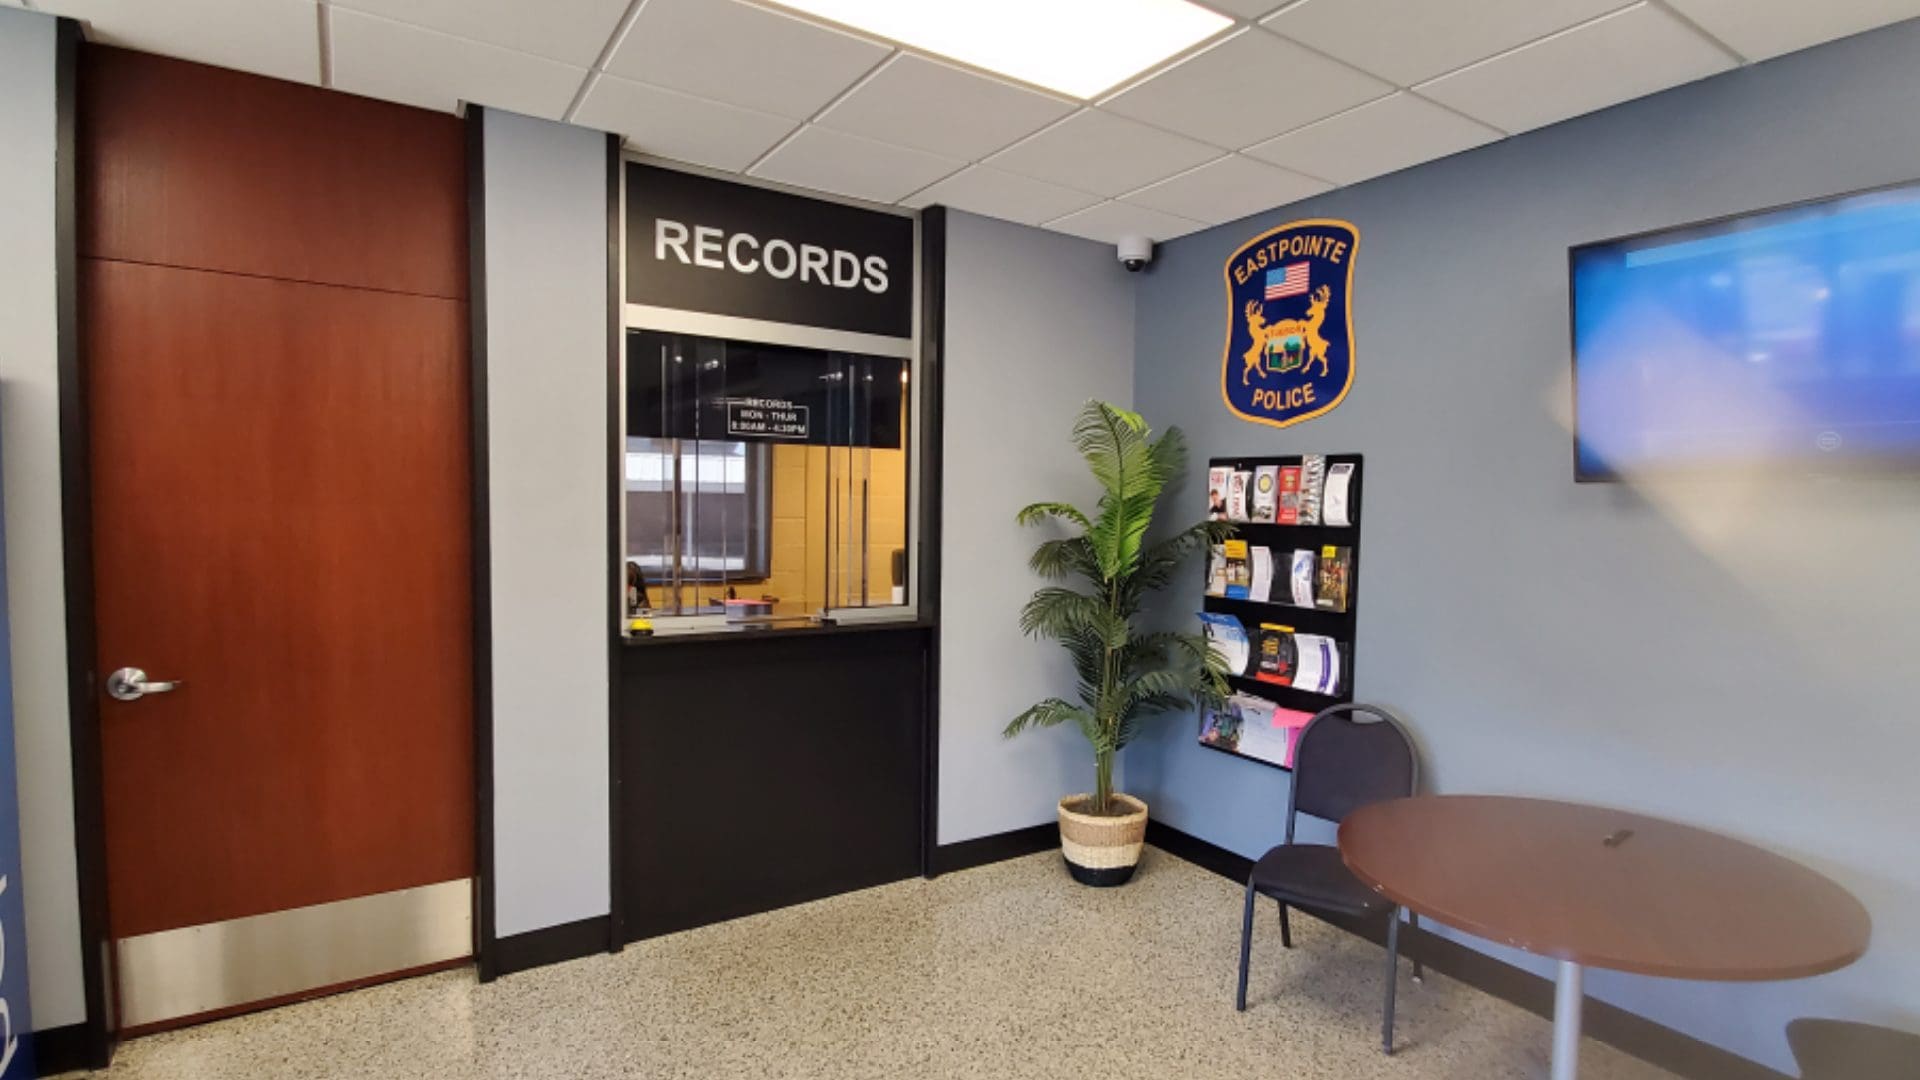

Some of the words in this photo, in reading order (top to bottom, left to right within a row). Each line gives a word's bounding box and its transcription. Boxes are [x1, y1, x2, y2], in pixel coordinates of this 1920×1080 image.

[654, 218, 889, 294] RECORDS
[1233, 234, 1347, 286] EASTPOINTE
[745, 398, 793, 410] RECORDS
[1251, 382, 1316, 411] POLICE
[740, 410, 763, 419] MON
[771, 412, 797, 422] THUR
